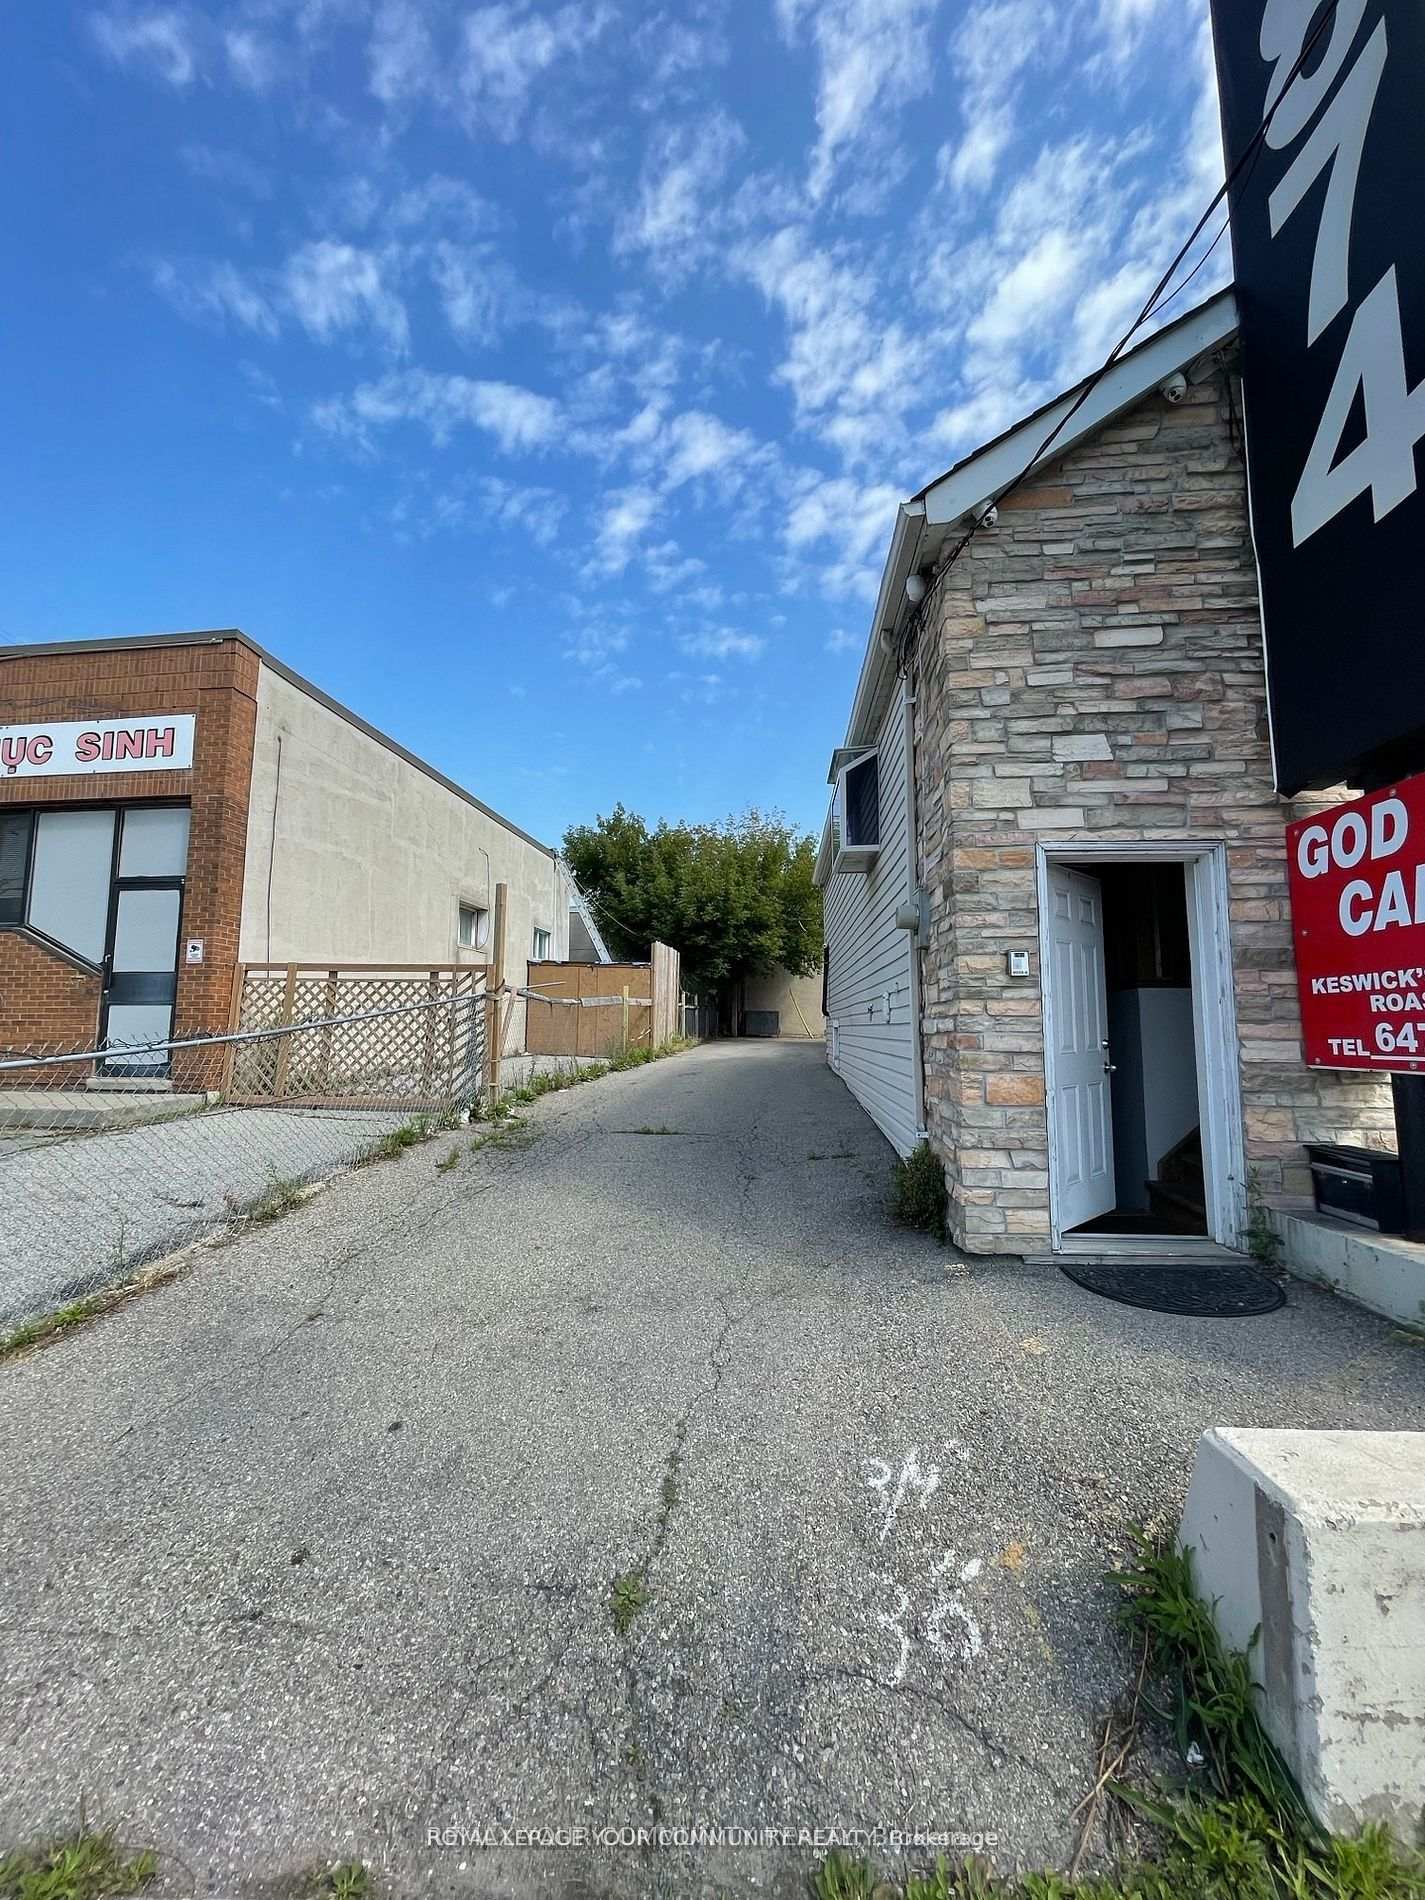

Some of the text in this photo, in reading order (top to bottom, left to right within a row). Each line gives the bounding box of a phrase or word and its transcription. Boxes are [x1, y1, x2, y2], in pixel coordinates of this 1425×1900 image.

[0, 727, 175, 774] ỤC SINH
[1297, 797, 1409, 879] GOD
[1311, 967, 1425, 995] KESWICK'
[1369, 992, 1425, 1013] ROA
[1327, 1022, 1425, 1056] TEL 64
